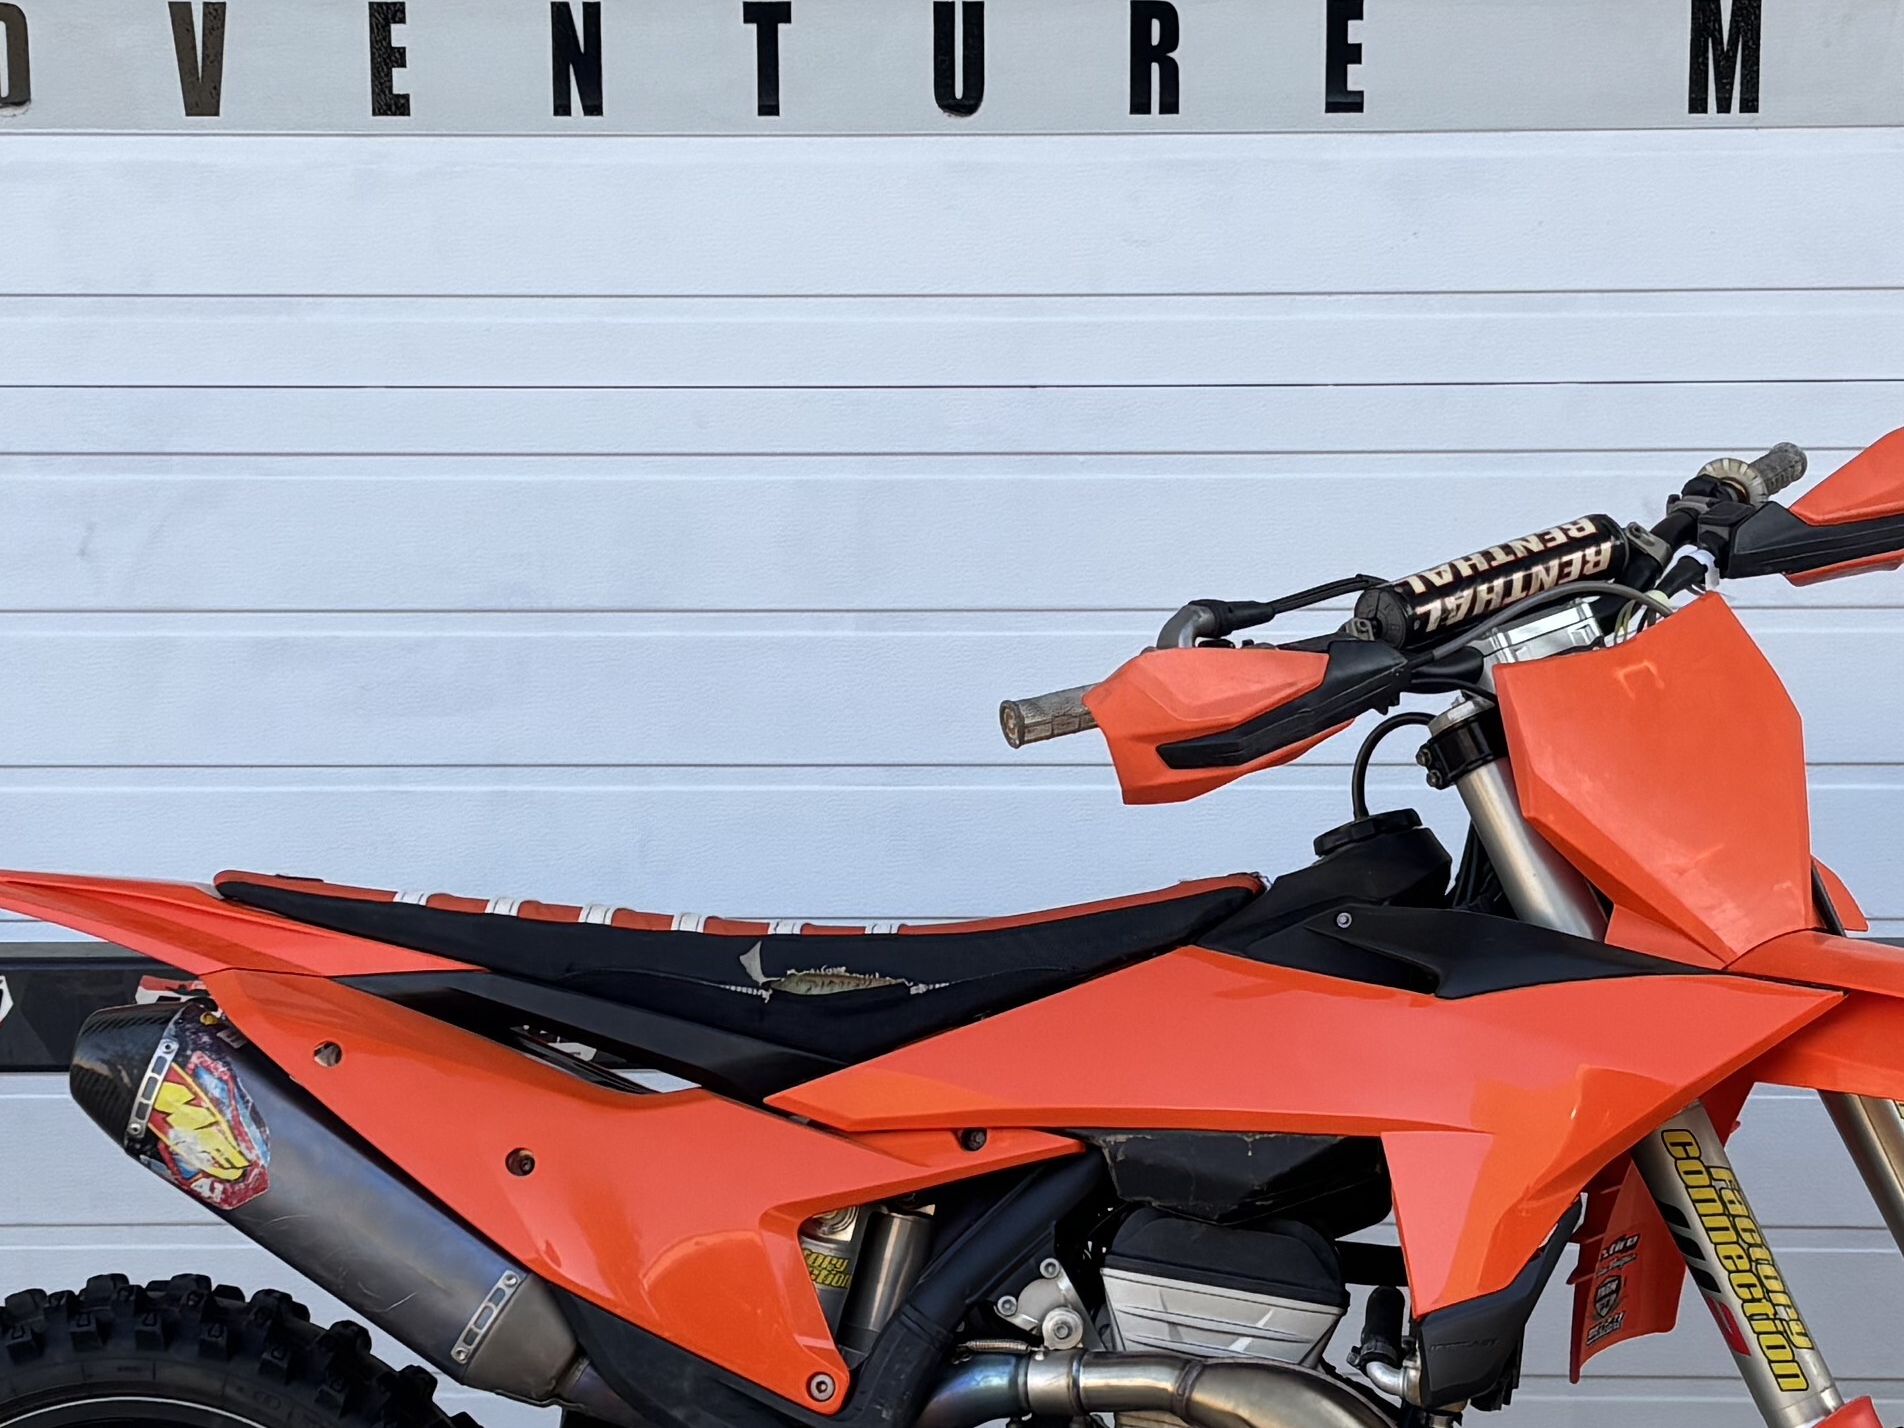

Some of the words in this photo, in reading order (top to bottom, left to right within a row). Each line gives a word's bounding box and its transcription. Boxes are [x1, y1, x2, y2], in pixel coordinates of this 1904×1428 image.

[1395, 517, 1597, 595] RENTHAL
[1415, 541, 1612, 633] RENTHAL
[1661, 1128, 1809, 1392] Connection
